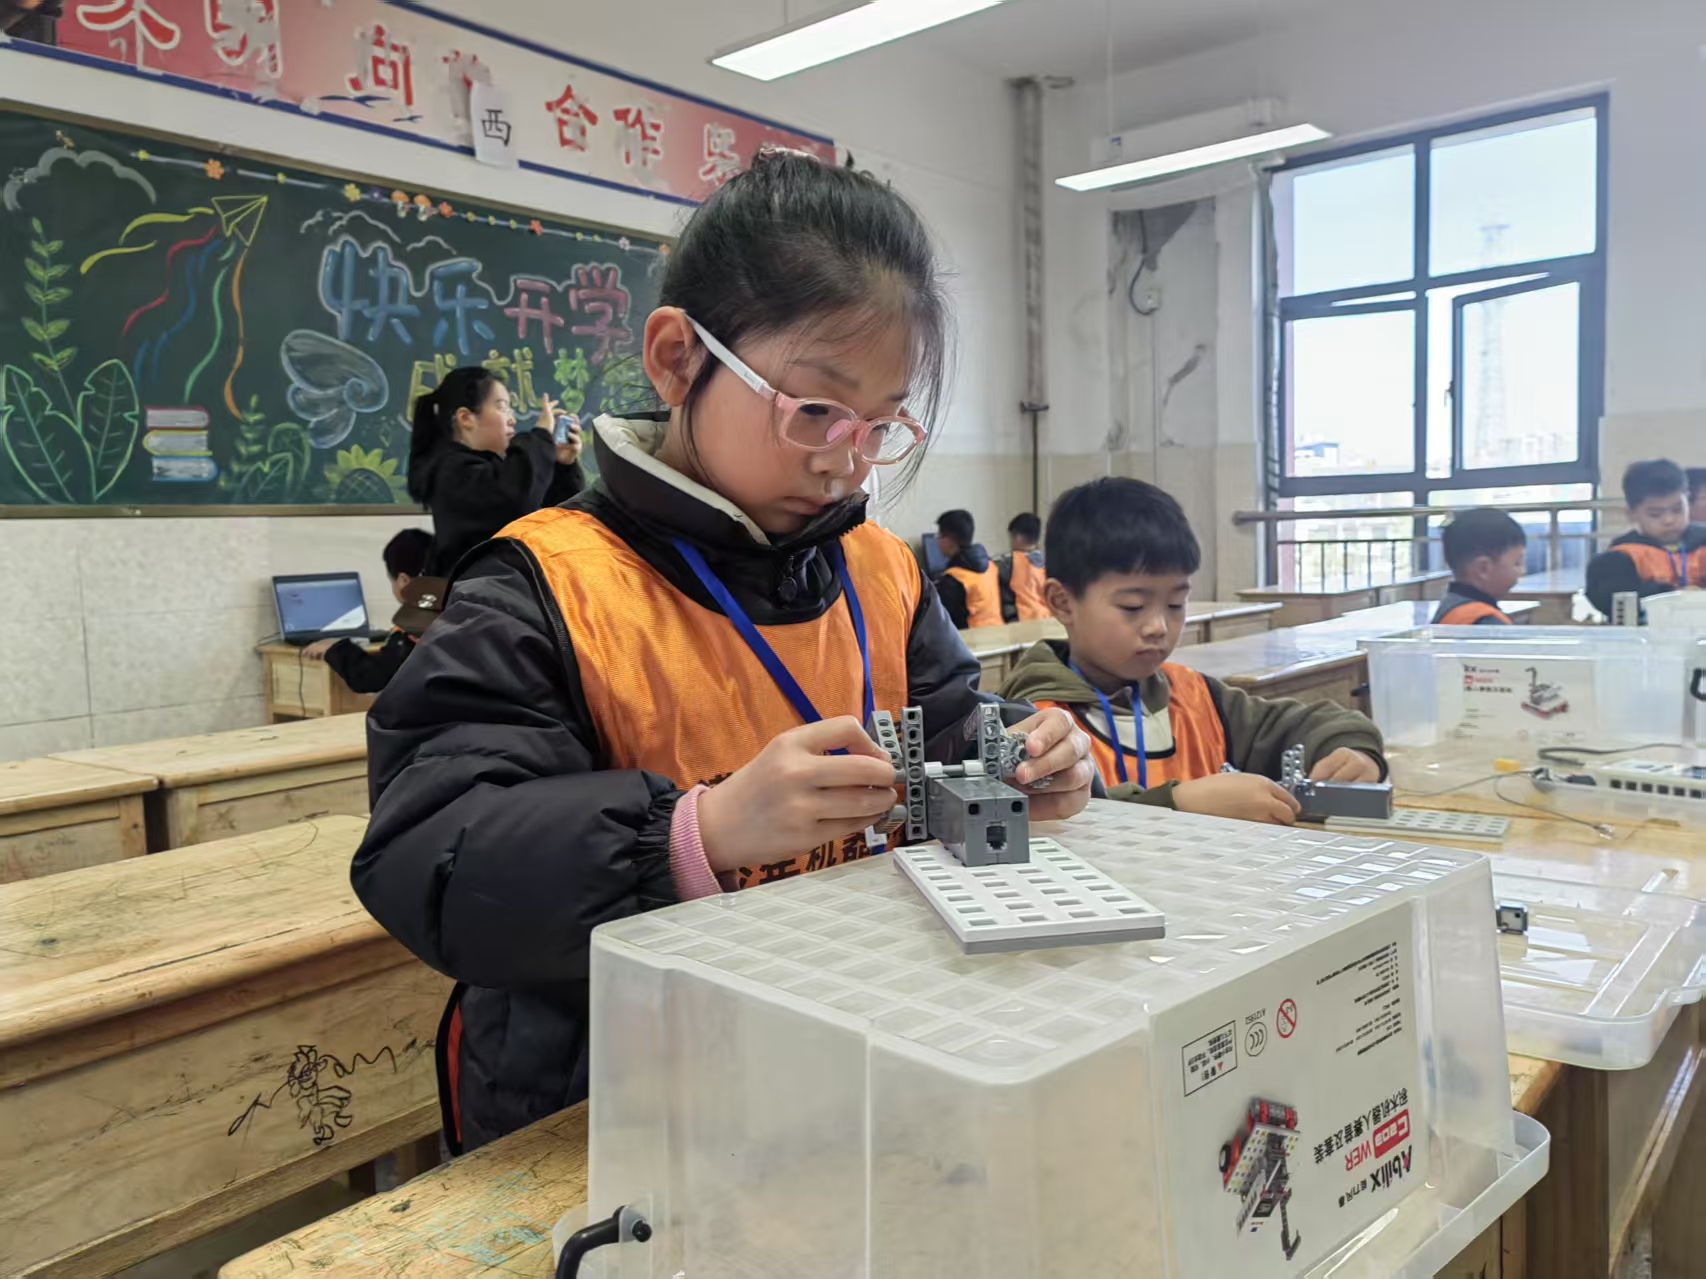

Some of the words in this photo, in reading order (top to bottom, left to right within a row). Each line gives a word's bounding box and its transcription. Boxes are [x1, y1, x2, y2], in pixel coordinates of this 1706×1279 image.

[481, 108, 513, 147] 西
[322, 241, 631, 364] 快乐开学
[1345, 1139, 1372, 1172] WER
